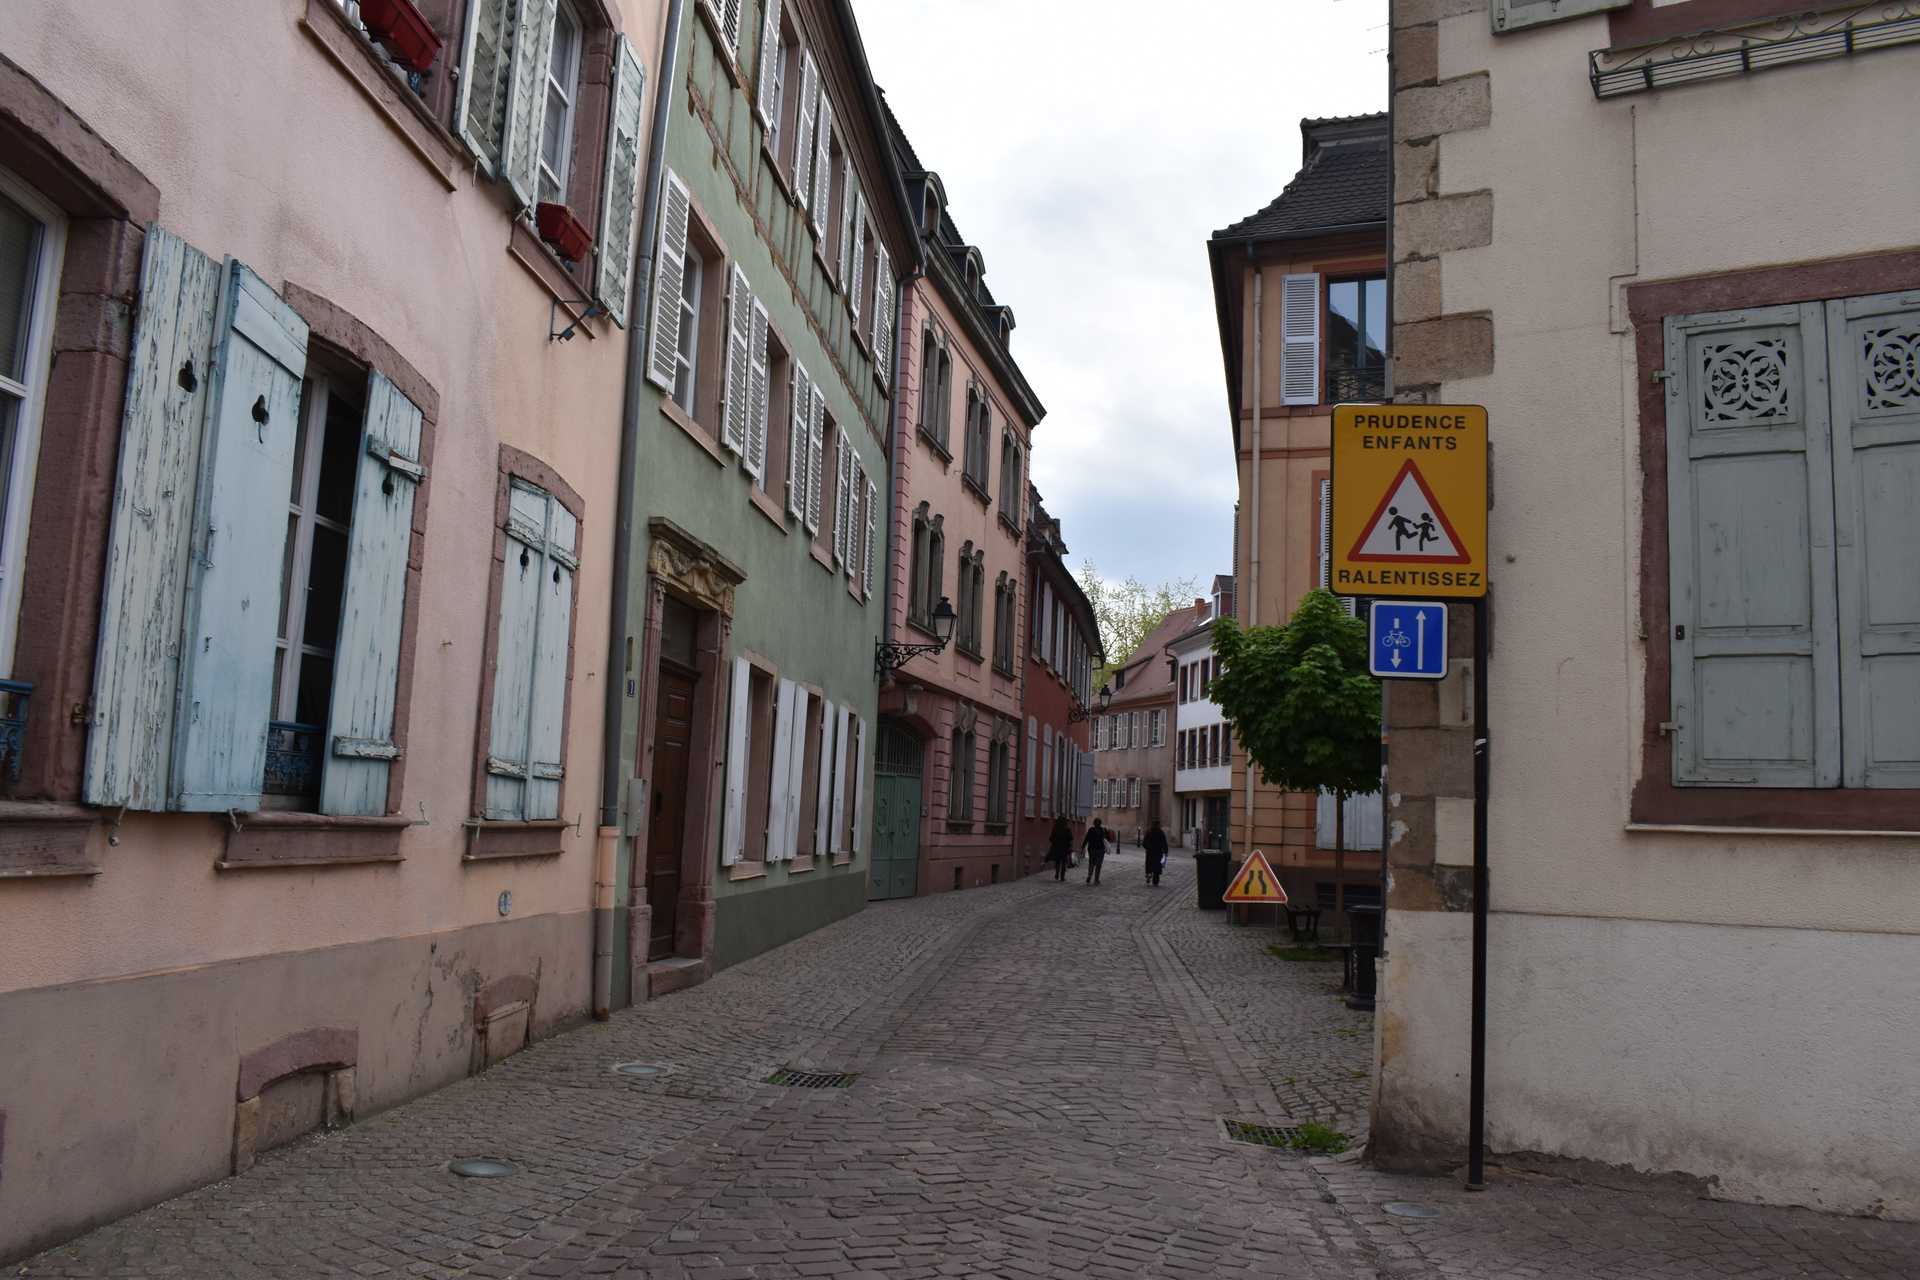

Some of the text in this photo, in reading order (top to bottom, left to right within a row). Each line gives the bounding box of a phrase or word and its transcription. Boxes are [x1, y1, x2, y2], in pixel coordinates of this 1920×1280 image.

[1354, 415, 1466, 430] PRUDENCE
[1362, 435, 1457, 450] ENFANTS
[1338, 569, 1481, 587] RALENTISSEZ
